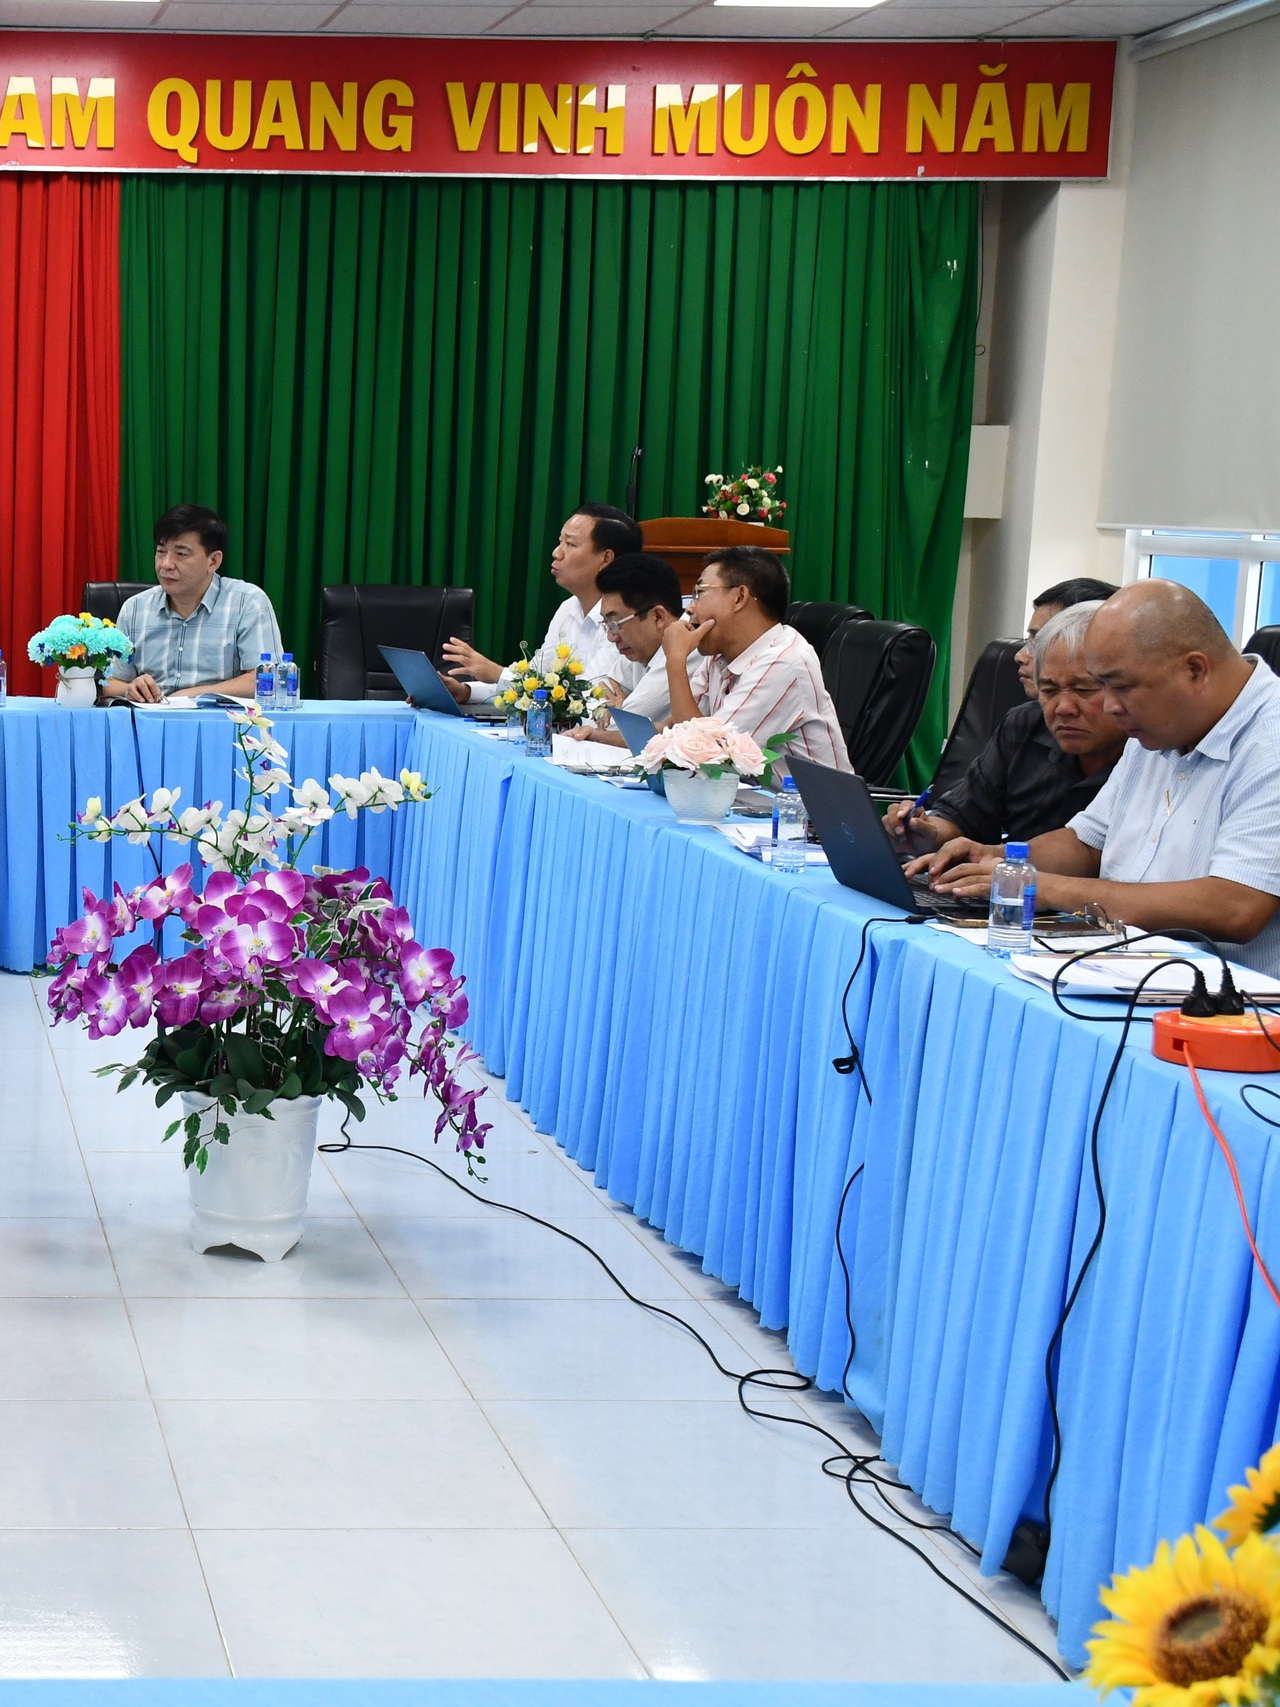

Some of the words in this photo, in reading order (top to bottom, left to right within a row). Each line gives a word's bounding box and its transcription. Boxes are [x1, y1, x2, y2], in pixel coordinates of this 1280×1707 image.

[146, 77, 414, 163] QUANG
[446, 82, 626, 155] VINH
[652, 62, 882, 156] MUÔN
[906, 63, 1091, 154] NĂM
